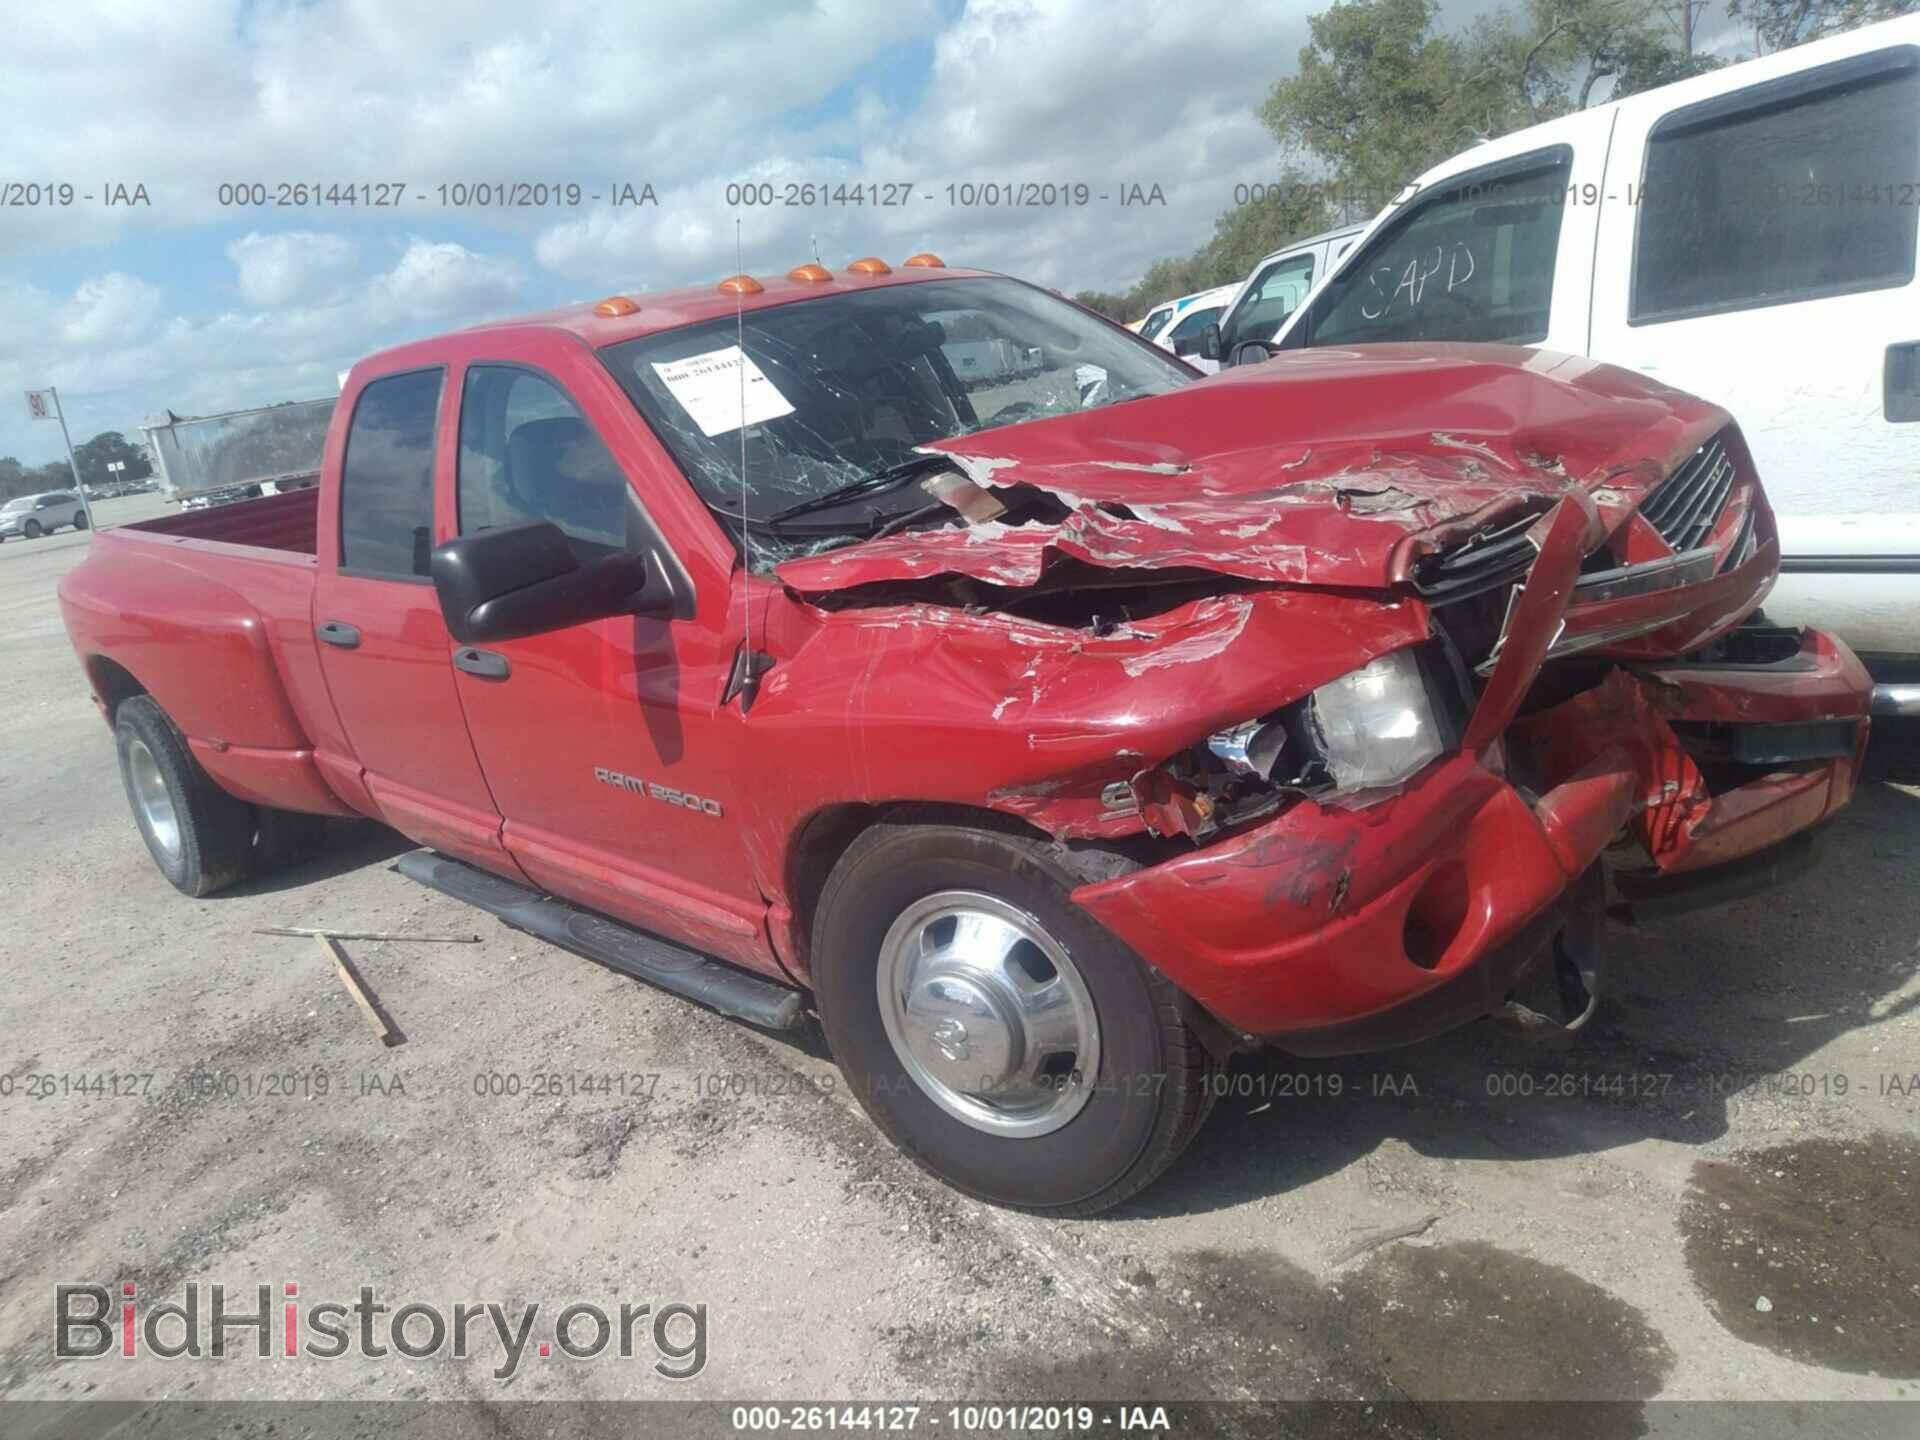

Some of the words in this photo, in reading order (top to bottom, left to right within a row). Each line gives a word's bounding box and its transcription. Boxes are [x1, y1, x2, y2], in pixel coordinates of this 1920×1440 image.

[1361, 242, 1475, 319] SAPD
[594, 767, 645, 797] RAM
[649, 782, 723, 816] 3500
